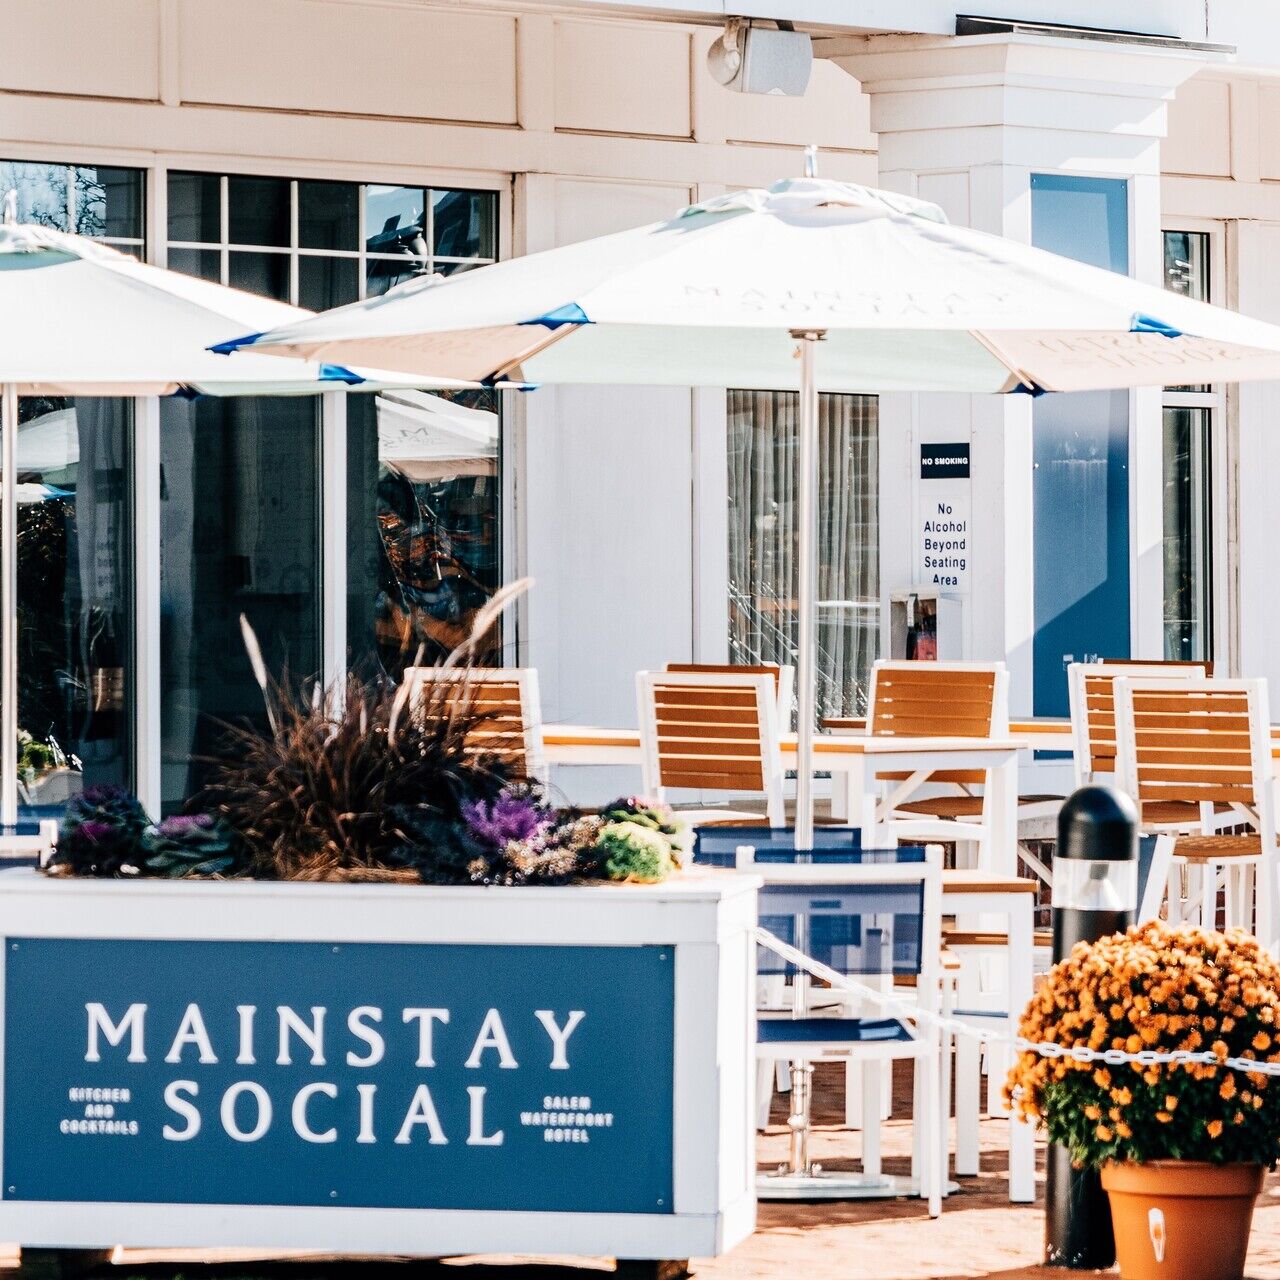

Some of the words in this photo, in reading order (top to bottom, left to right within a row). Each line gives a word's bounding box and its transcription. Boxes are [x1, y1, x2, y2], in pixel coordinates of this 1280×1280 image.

[922, 457, 933, 466] NO
[934, 456, 969, 466] SMOKING
[937, 503, 953, 515] No
[924, 521, 967, 533] Alcohol
[924, 538, 966, 553] Beyond
[924, 556, 966, 571] Seating
[933, 573, 958, 586] Area
[84, 1002, 586, 1070] MAINSTAY
[69, 1087, 130, 1103] KITCHEN
[543, 1095, 591, 1110] SALEM
[84, 1104, 114, 1118] AND
[162, 1079, 504, 1146] SOCIAL
[520, 1111, 613, 1127] WATERFRONT
[60, 1119, 139, 1135] COCKTAILS
[543, 1128, 589, 1143] HOTEL
